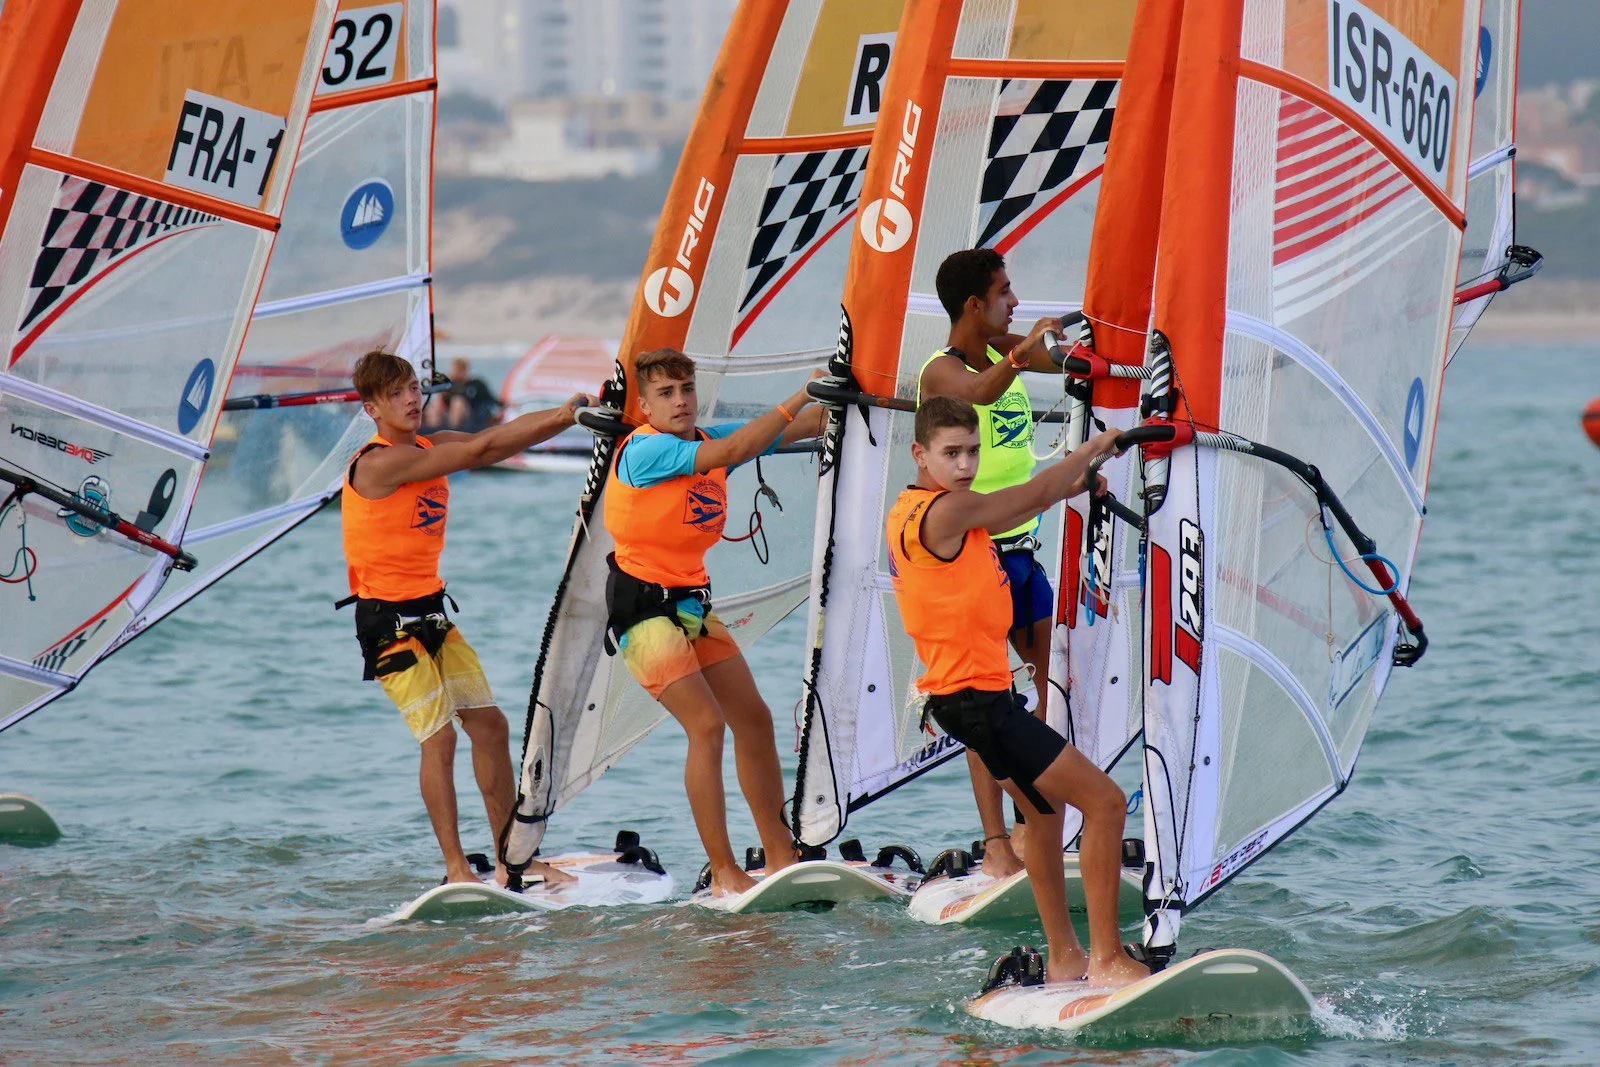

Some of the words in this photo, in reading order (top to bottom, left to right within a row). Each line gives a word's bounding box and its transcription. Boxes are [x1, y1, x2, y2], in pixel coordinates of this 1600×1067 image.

[322, 13, 393, 86] 32
[1333, 0, 1450, 173] ISR-660
[166, 99, 285, 196] FRA-1
[890, 98, 923, 200] RIG
[676, 176, 716, 270] RIG
